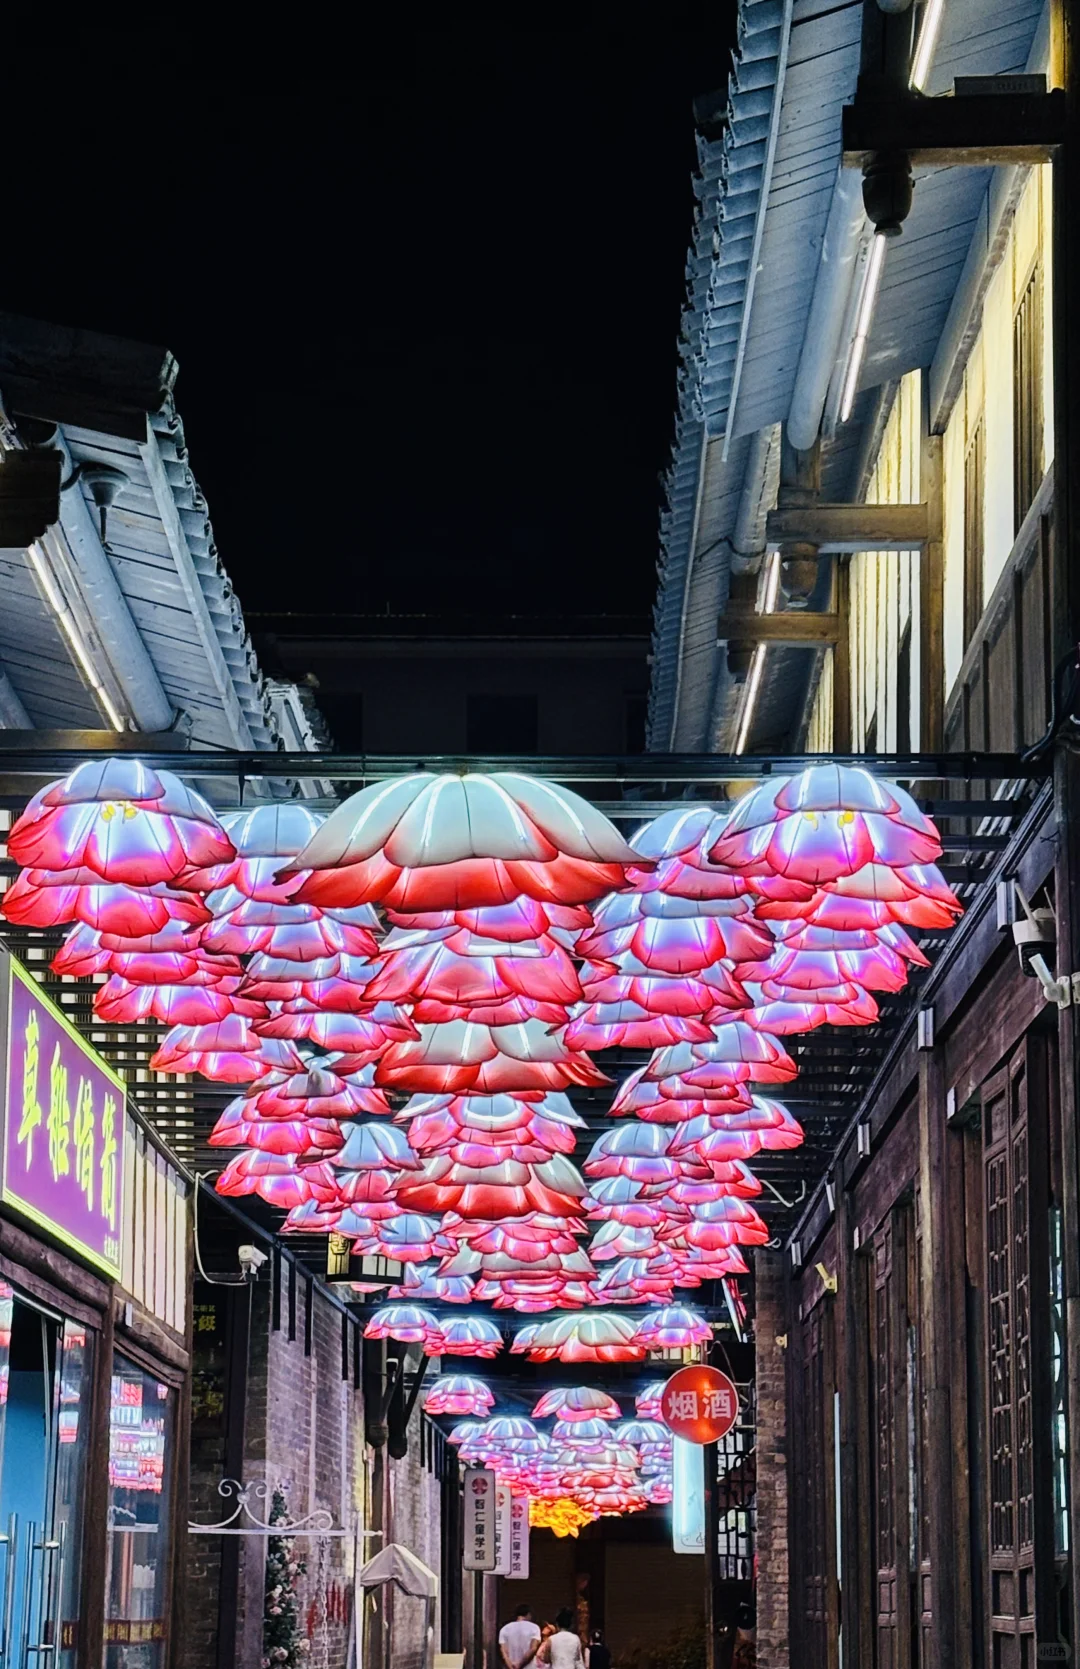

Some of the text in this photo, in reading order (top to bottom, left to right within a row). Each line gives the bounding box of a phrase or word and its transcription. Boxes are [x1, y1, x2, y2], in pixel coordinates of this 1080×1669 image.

[668, 1390, 732, 1421] 烟酒
[475, 1499, 485, 1560] 智仁童学馆
